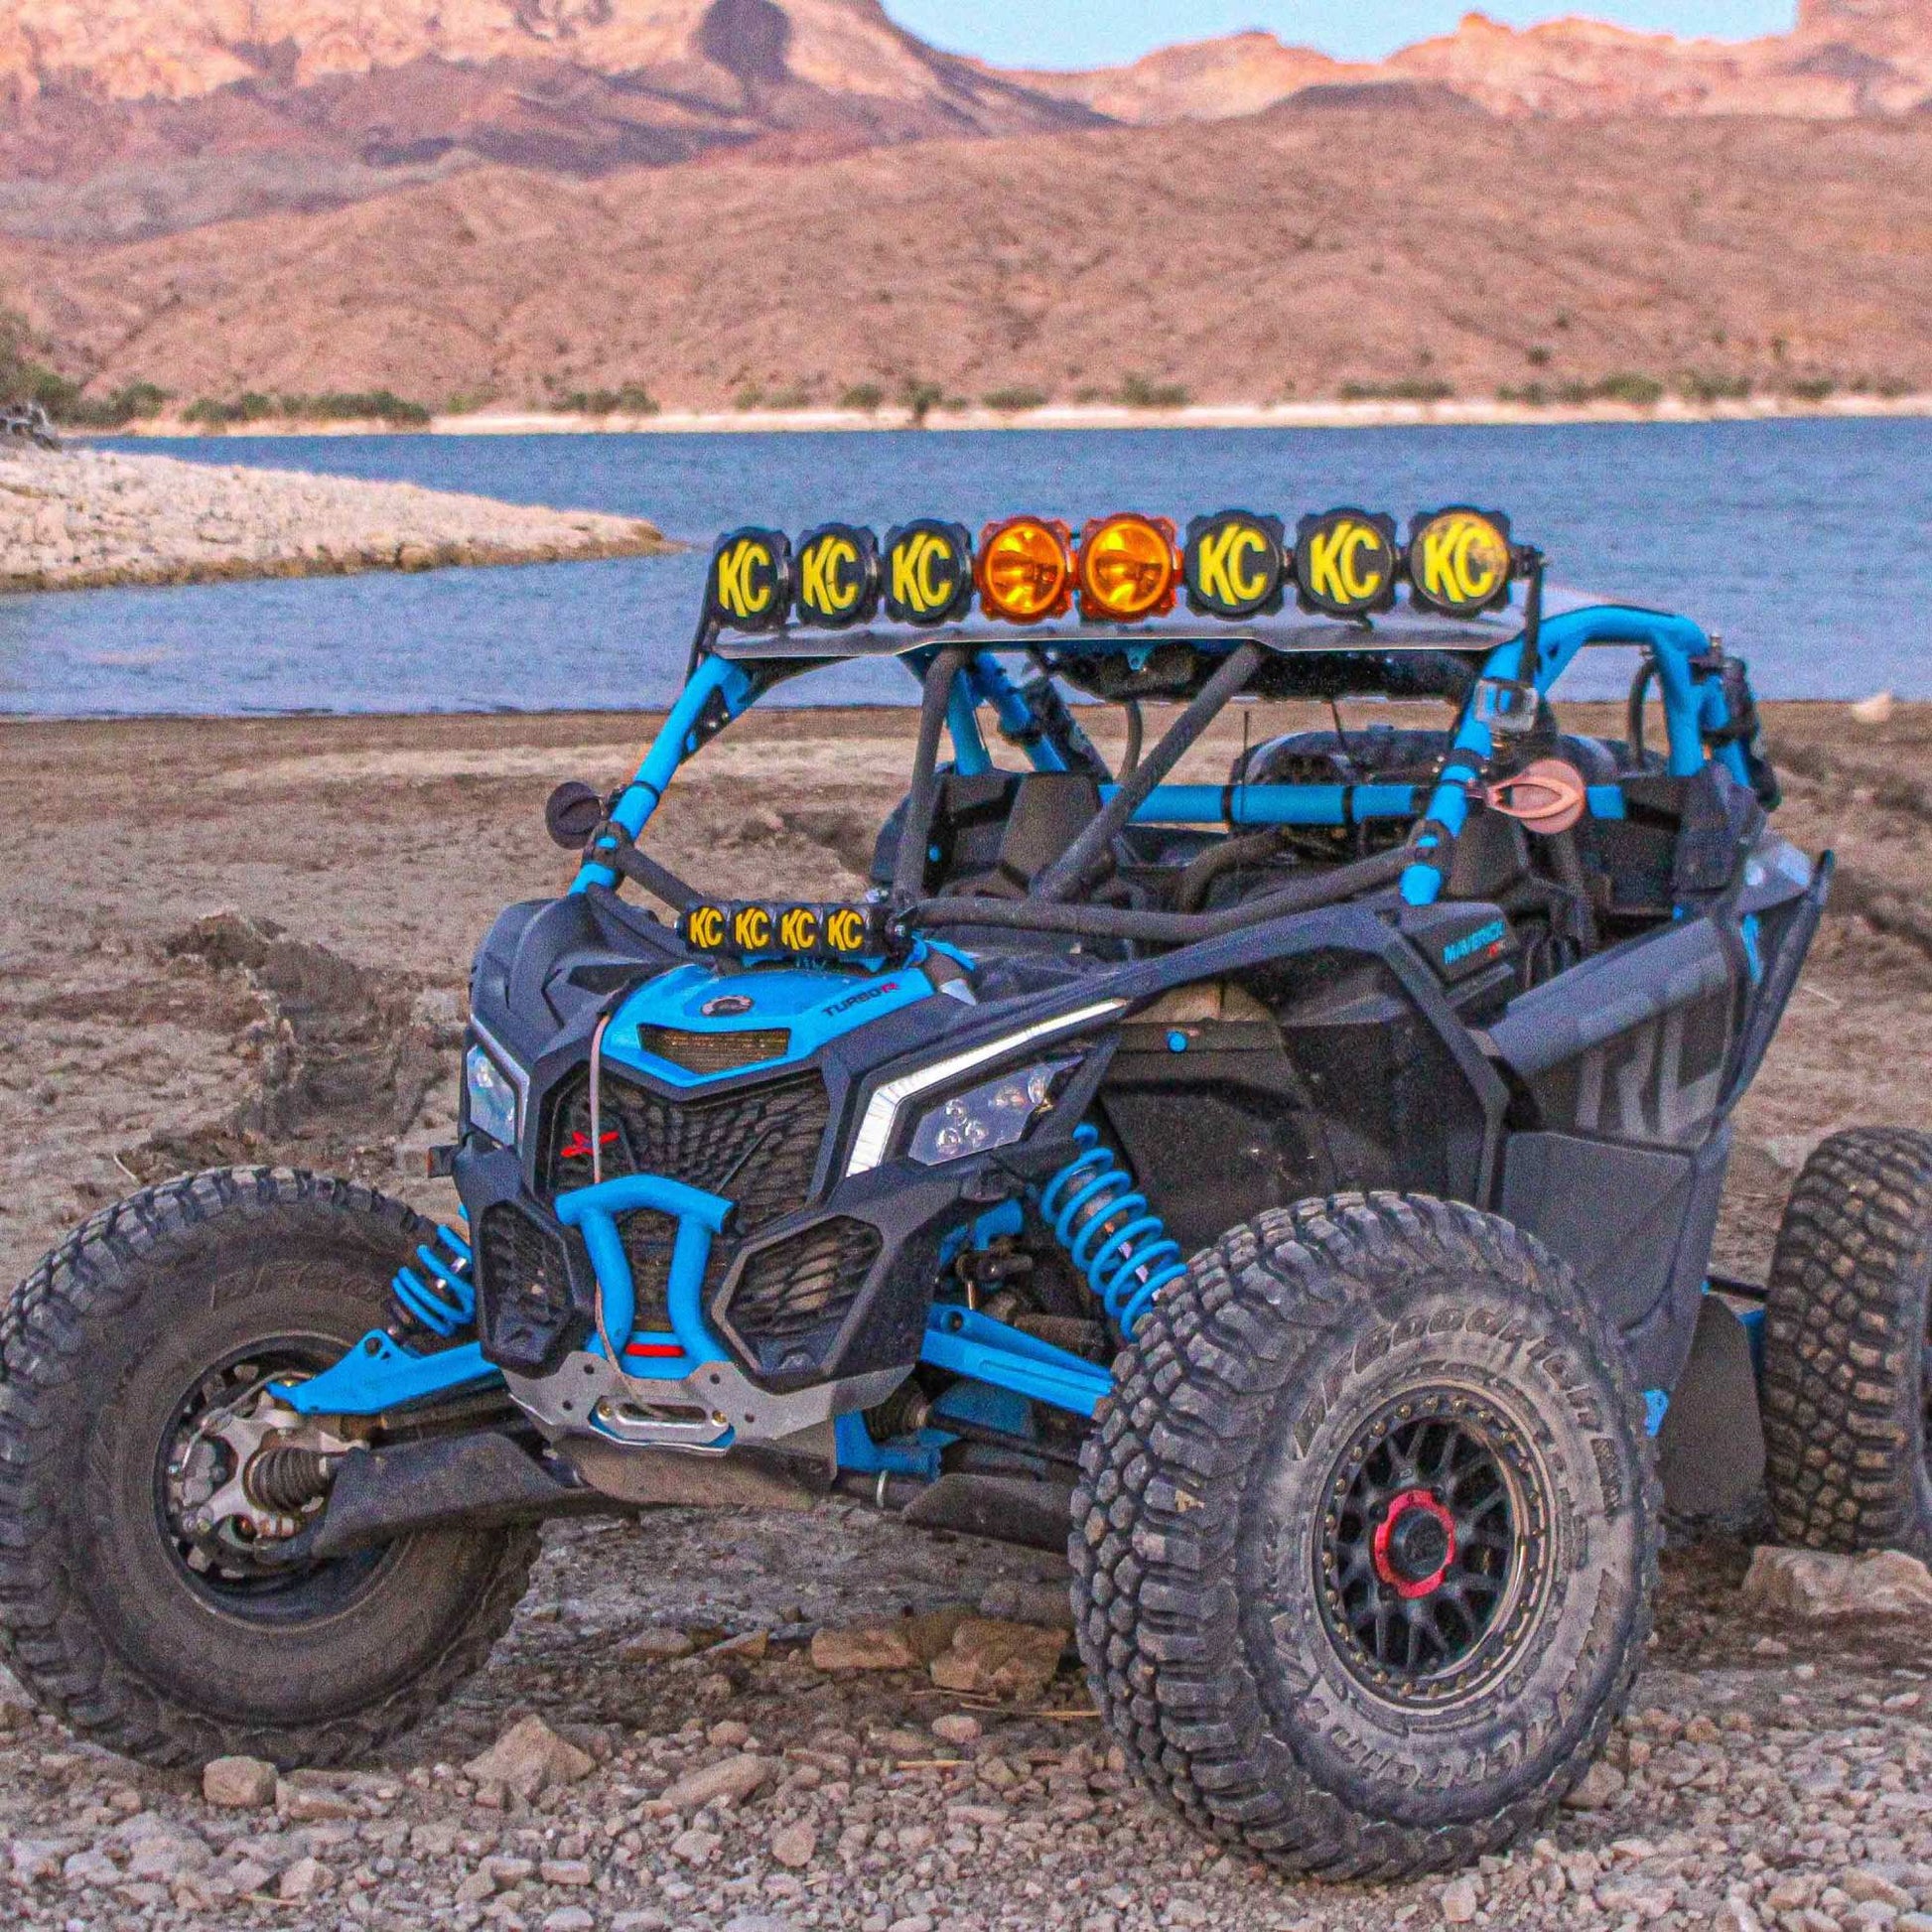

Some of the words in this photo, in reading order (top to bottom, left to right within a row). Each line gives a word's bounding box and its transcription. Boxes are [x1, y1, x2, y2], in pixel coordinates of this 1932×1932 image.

[719, 539, 770, 618] KC
[803, 535, 858, 616] KC
[893, 531, 952, 614] KC
[1199, 523, 1268, 606] KC
[1310, 520, 1382, 605] KC
[1424, 518, 1495, 604] KC
[689, 907, 725, 949] KC
[735, 907, 771, 950] KC
[780, 908, 816, 951] KC
[827, 908, 864, 952] KC
